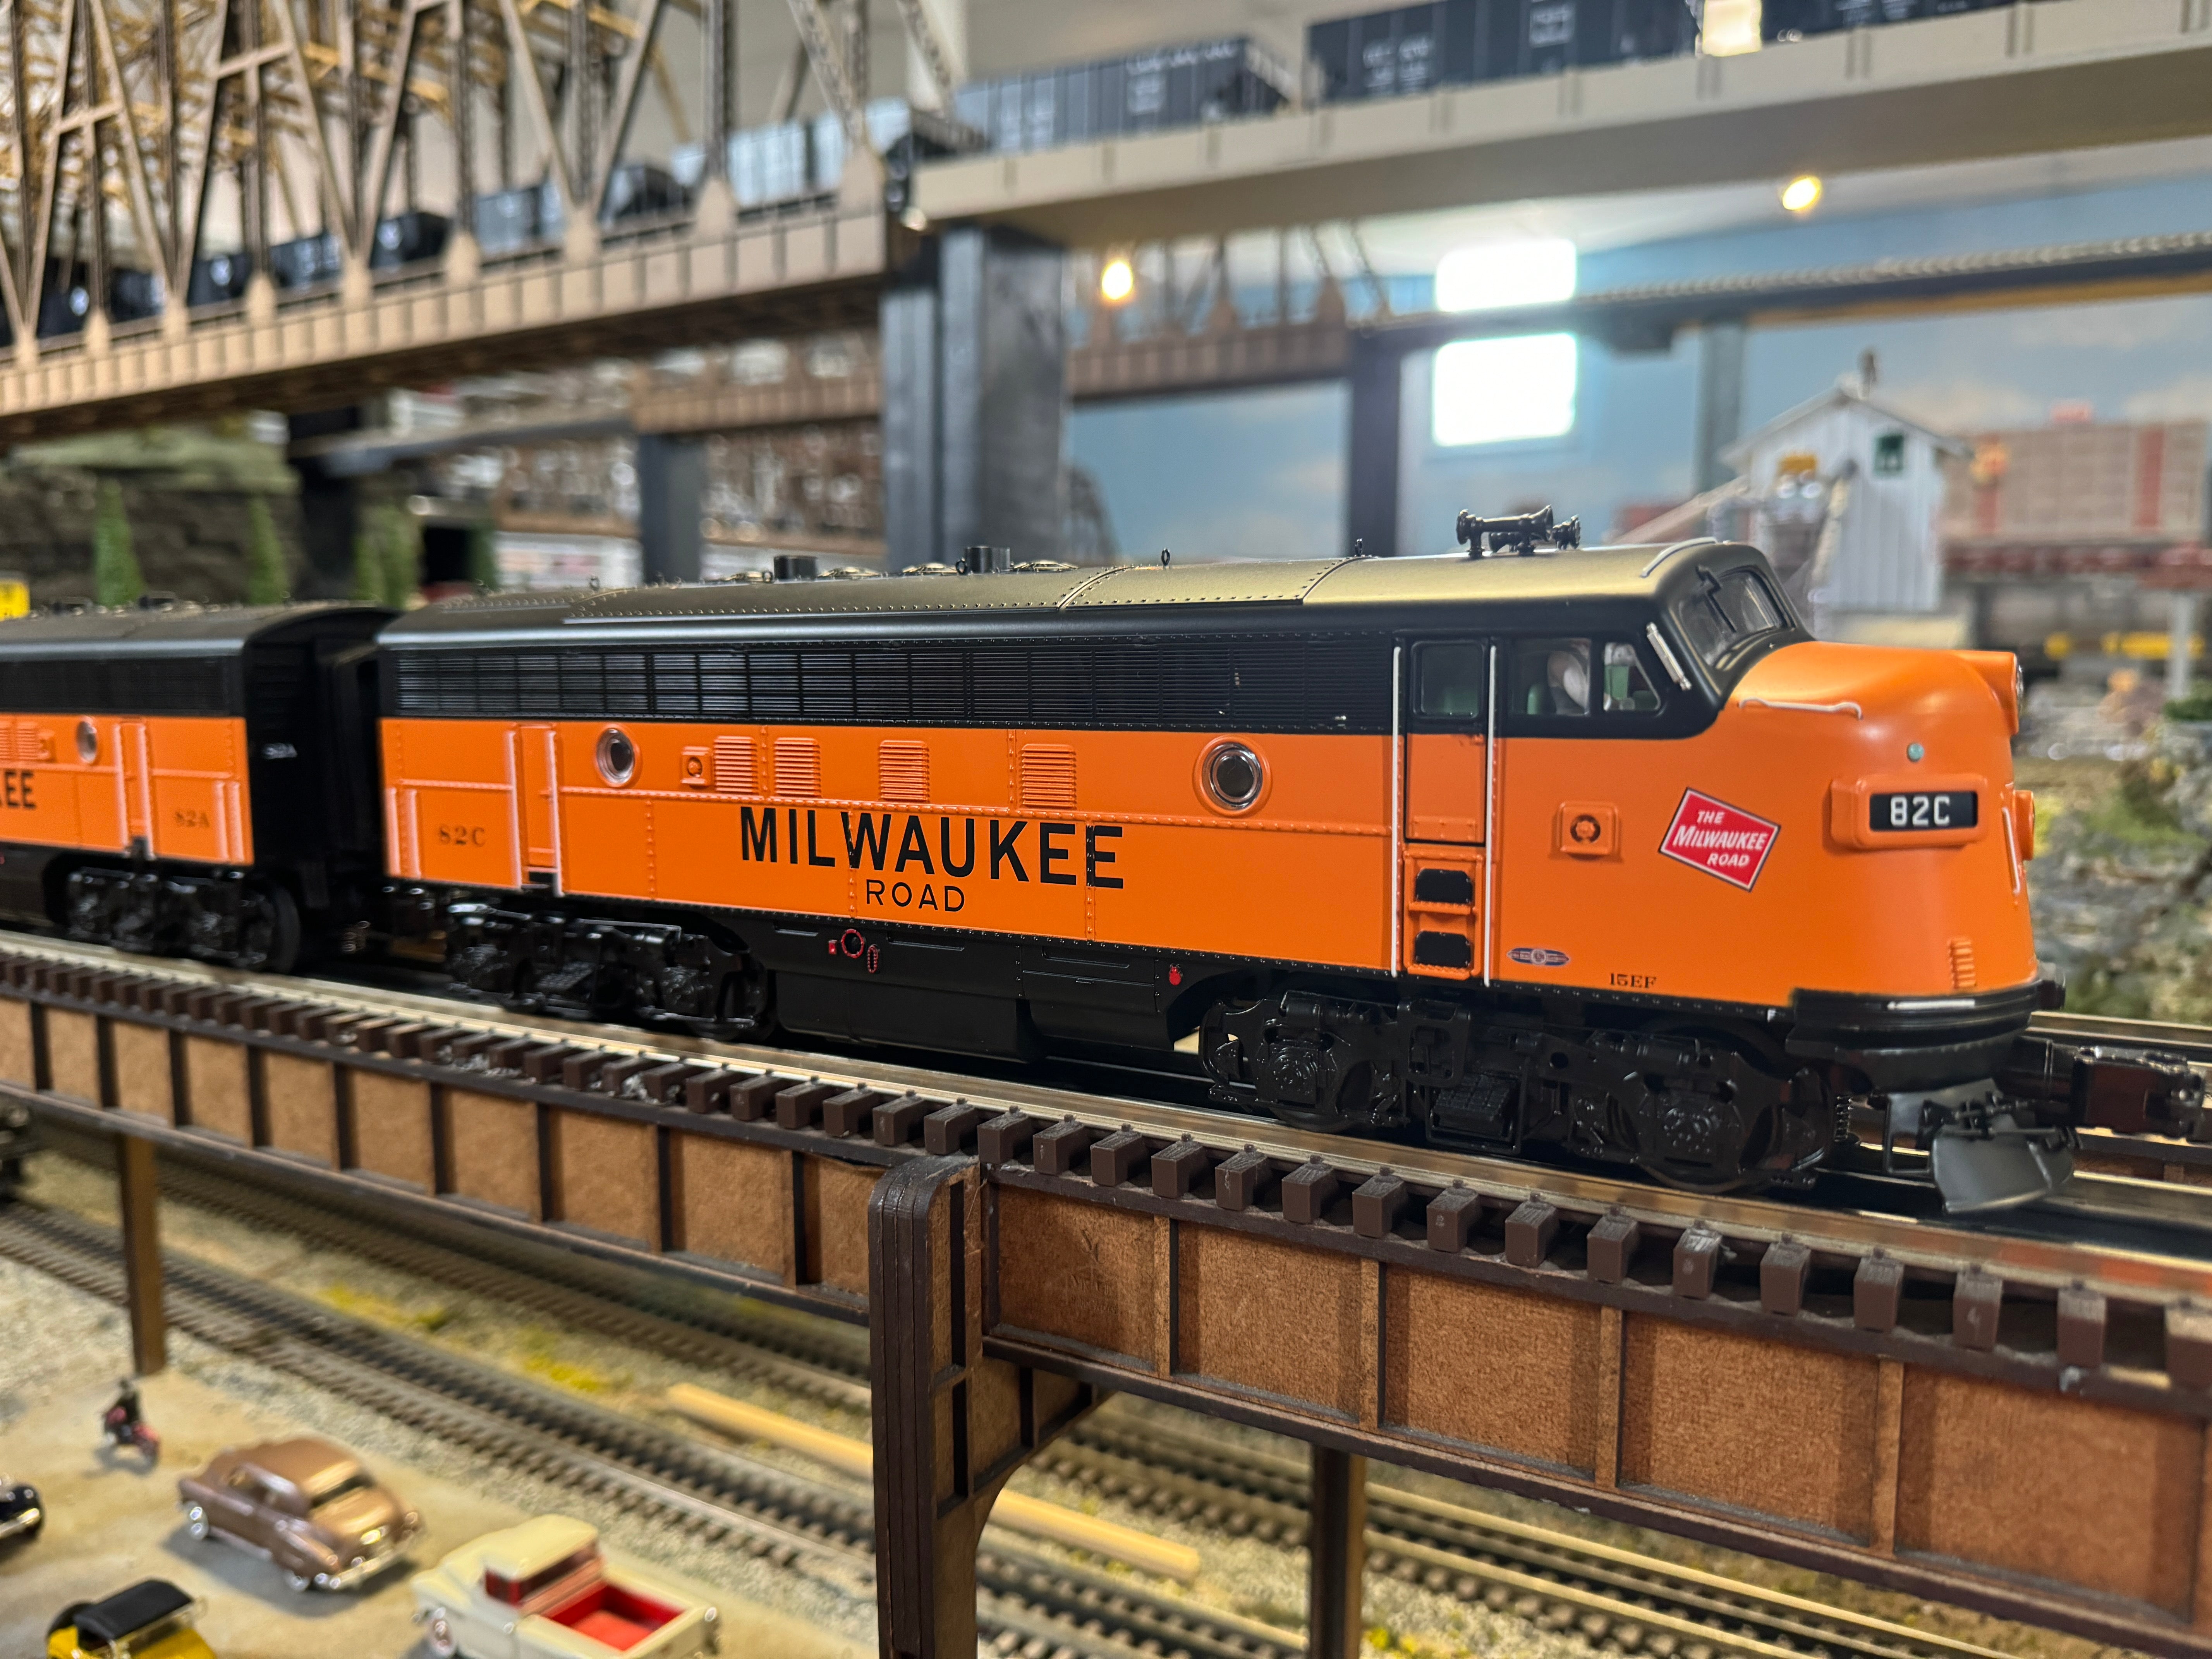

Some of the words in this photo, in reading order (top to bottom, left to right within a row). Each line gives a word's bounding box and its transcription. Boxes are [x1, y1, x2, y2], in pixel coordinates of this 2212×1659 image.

[0, 768, 36, 809] EE
[1697, 810, 1725, 824] THE
[1890, 795, 1950, 826] 82C
[439, 824, 486, 847] 82C
[740, 806, 1123, 889] MILWAUKEE
[1672, 826, 1769, 851] MILWAUKEE
[1707, 853, 1750, 867] ROAD
[866, 879, 965, 912] ROAD
[1611, 973, 1657, 988] 15EF
